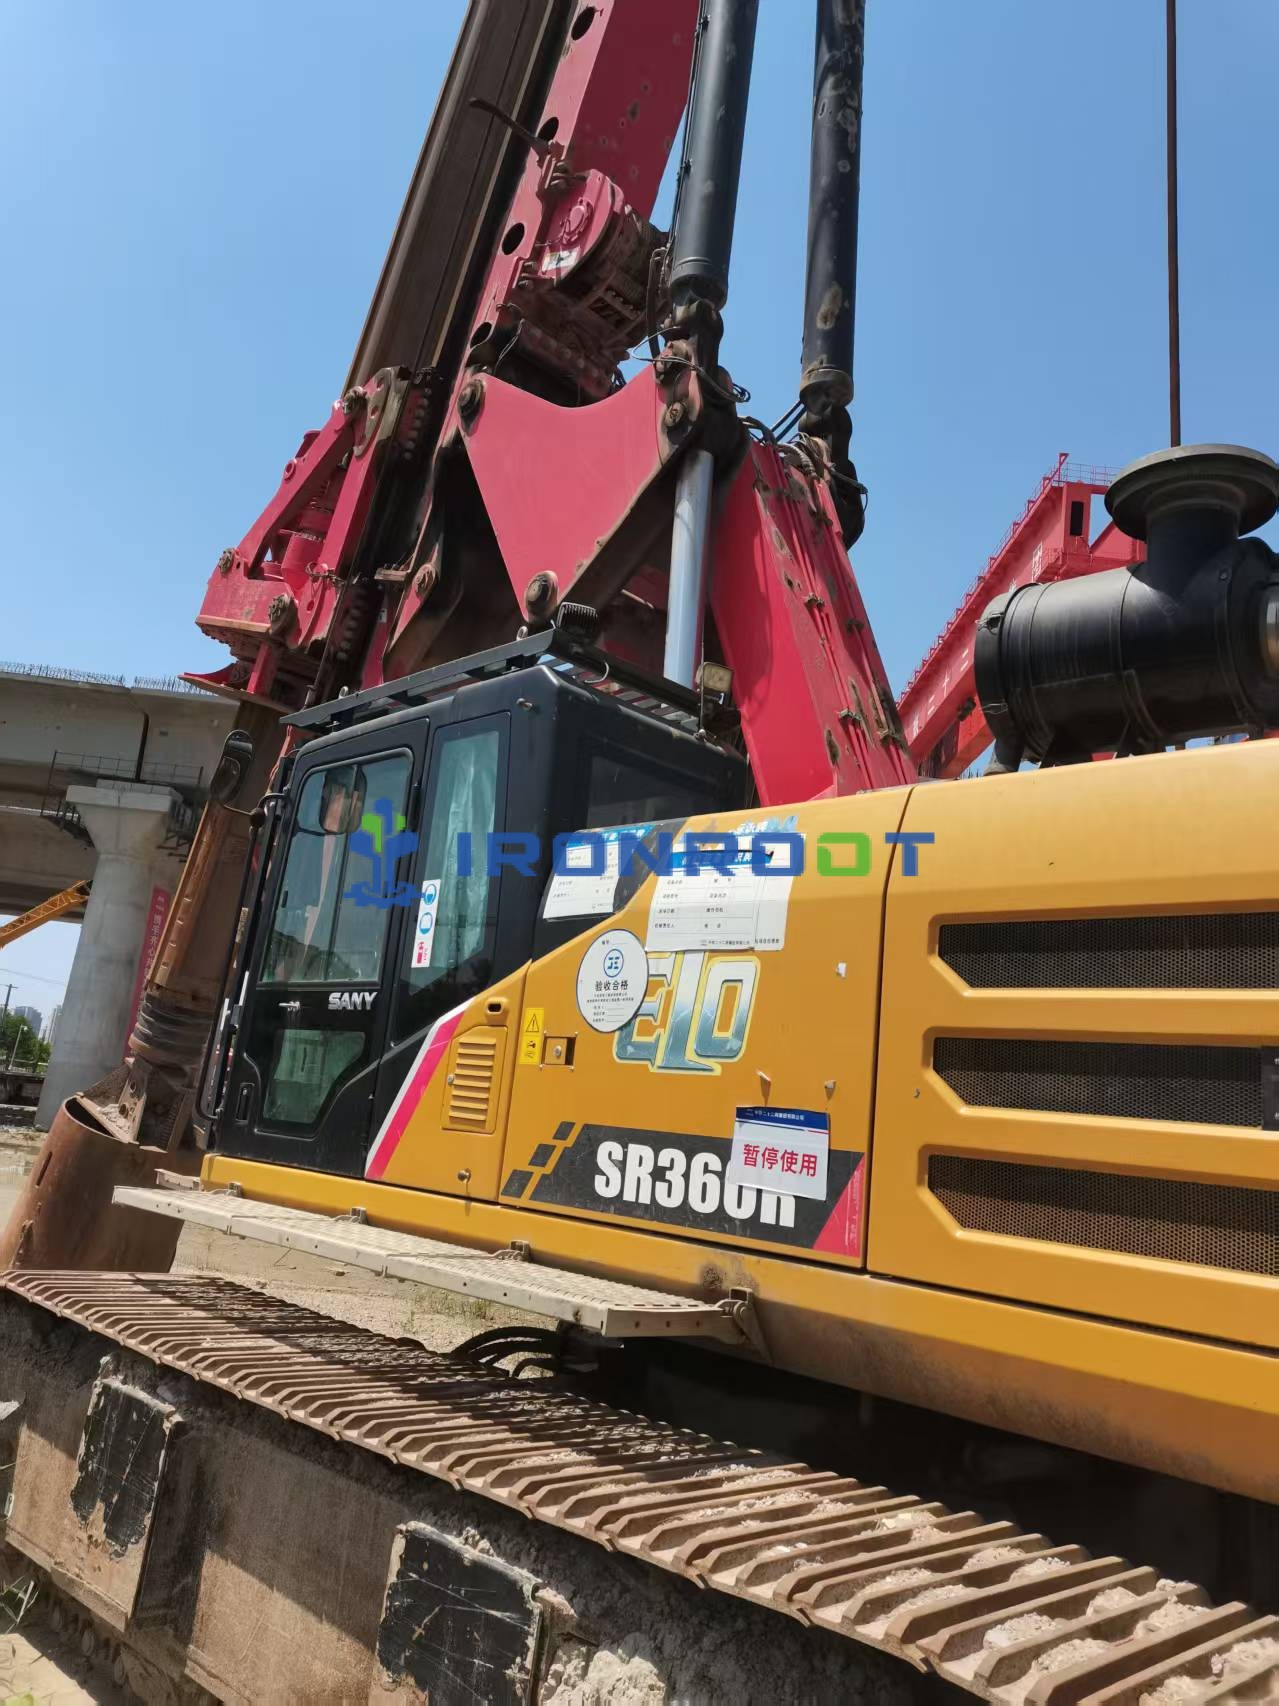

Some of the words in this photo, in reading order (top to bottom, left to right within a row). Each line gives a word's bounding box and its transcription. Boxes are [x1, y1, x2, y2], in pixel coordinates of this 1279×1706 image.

[595, 980, 629, 992] 验收合格
[328, 991, 378, 1012] SANY
[743, 1143, 818, 1177] 暂停使用
